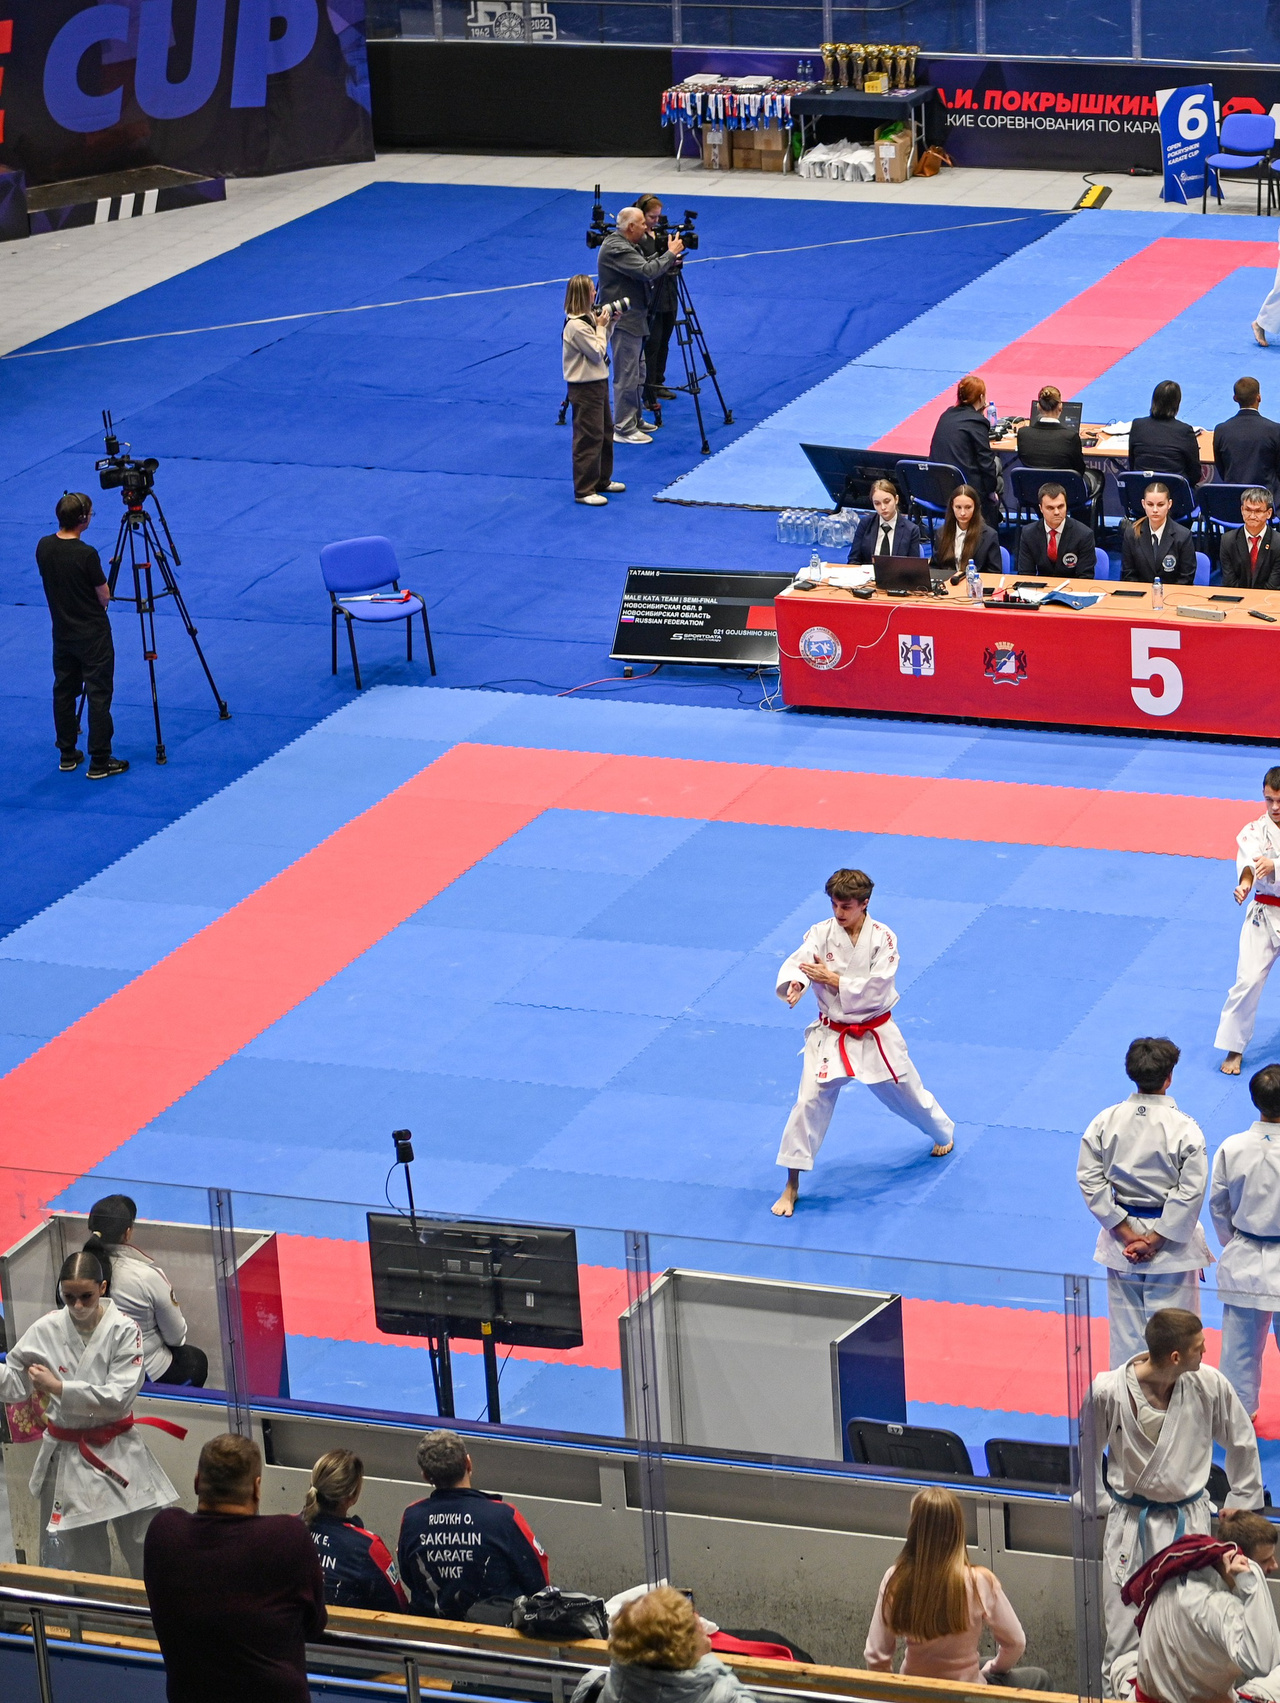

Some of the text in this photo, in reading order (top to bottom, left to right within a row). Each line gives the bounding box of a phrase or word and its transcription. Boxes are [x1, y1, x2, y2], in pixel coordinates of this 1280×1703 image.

[43, 0, 318, 134] CUP
[984, 90, 1158, 116] ПОКРЫШКИН
[945, 114, 975, 127] КИЕ
[978, 115, 1095, 132] СОРЕВНОВАНИЯ
[1099, 119, 1121, 133] ПО
[1178, 94, 1208, 140] 6
[1166, 142, 1182, 152] OPEN
[1168, 150, 1200, 166] KARATE CUP
[624, 602, 680, 611] НОВОСИБИРСКАЯ
[622, 610, 711, 619] НОВОСИБИРСКАЯ ОБЛАСТЬ
[1130, 628, 1183, 717] 5
[428, 1513, 474, 1526] RUDYKH O.
[420, 1532, 482, 1546] SAKHALIN
[426, 1549, 474, 1562] KARATE
[438, 1566, 464, 1579] WKF
